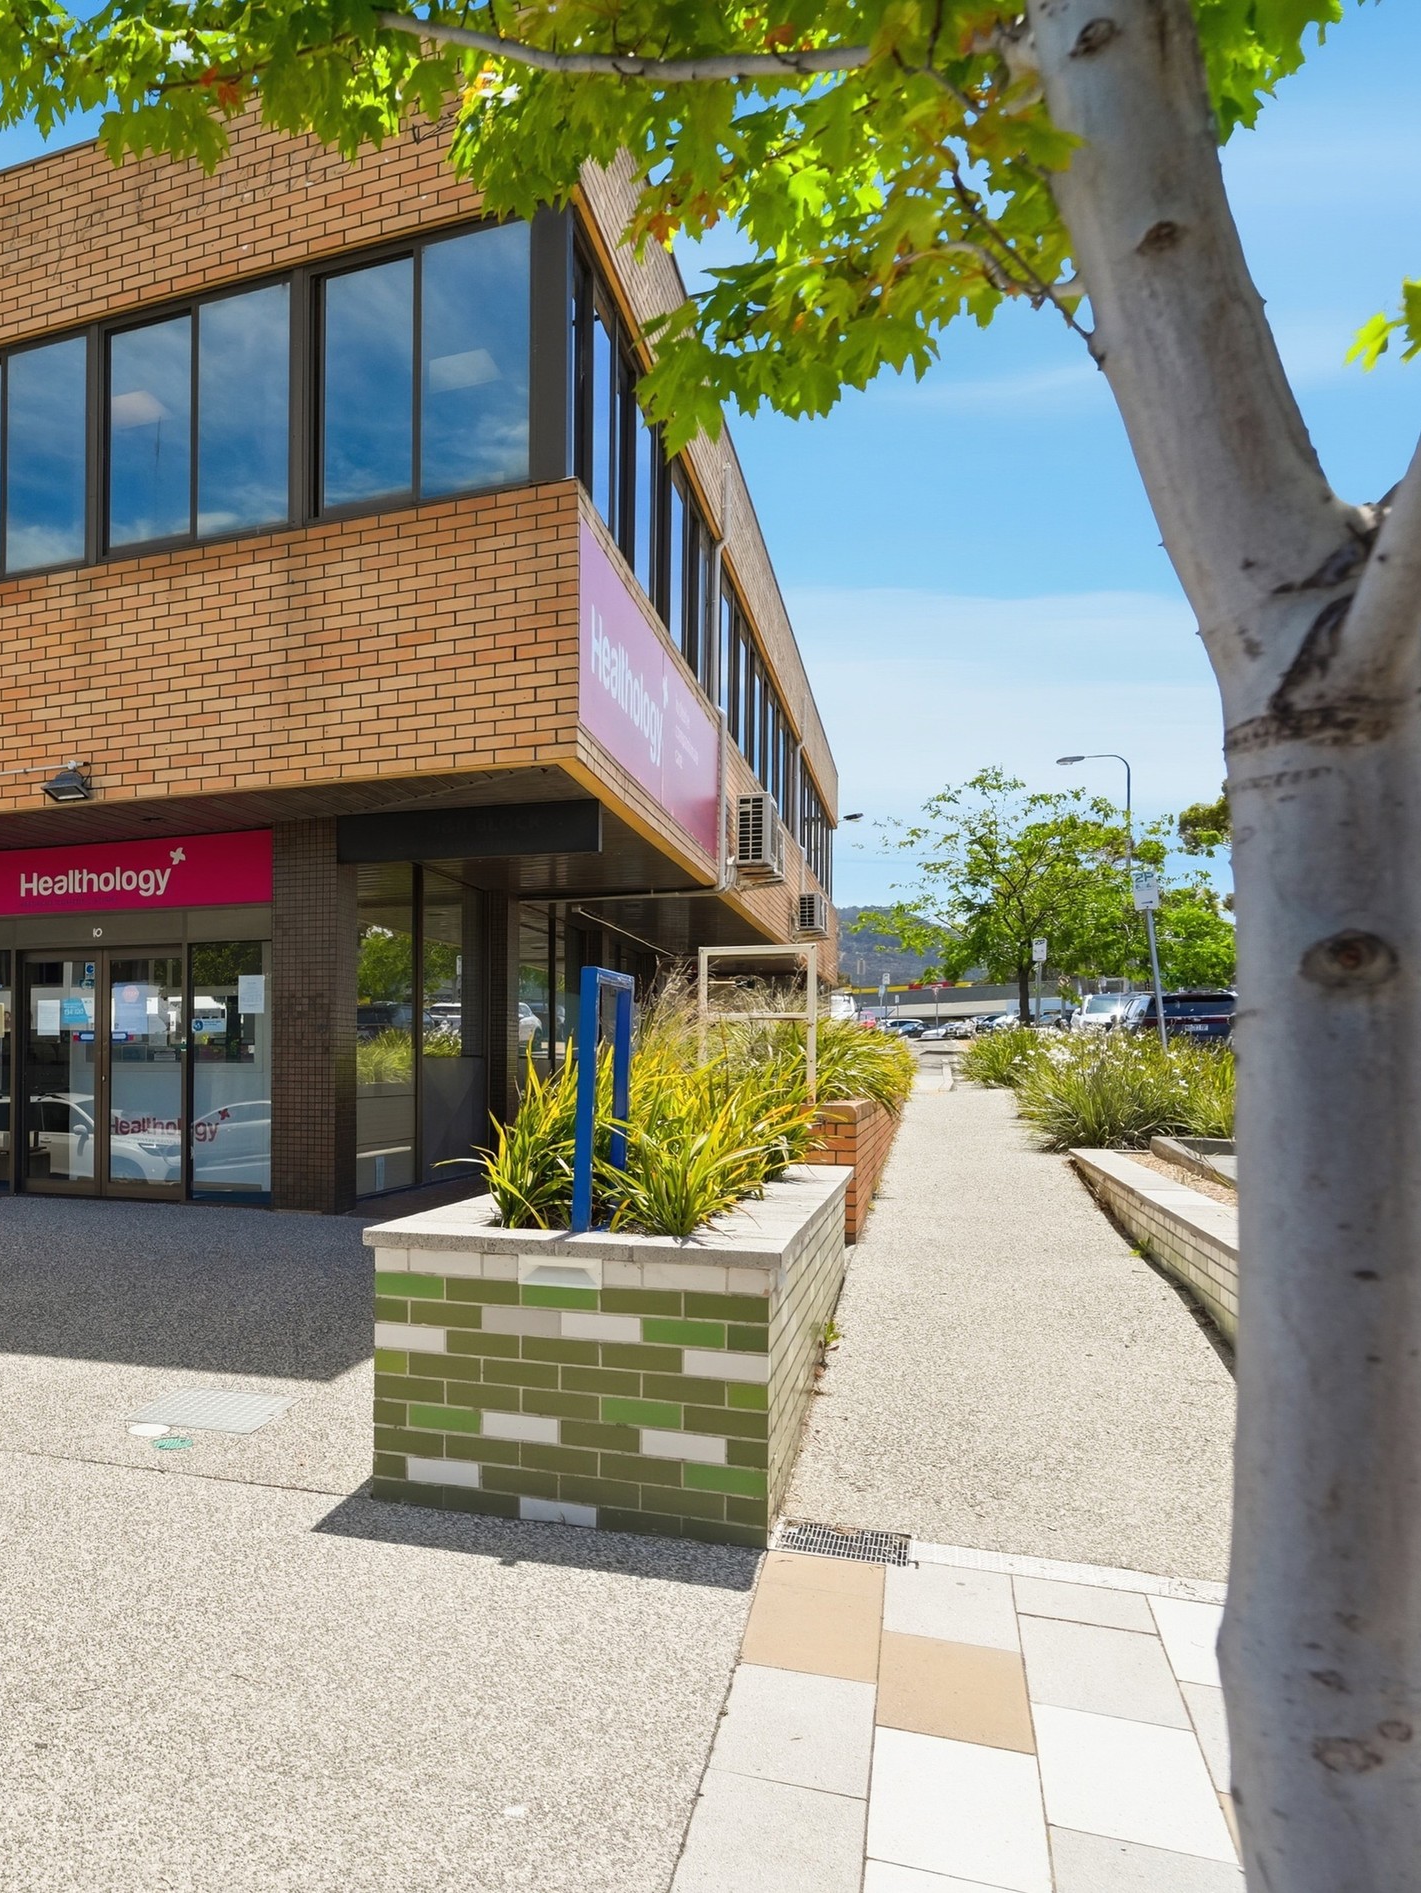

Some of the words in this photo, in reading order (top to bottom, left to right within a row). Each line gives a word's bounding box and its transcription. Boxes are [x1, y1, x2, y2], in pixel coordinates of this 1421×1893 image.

[591, 603, 664, 767] Healthology
[20, 866, 172, 897] Healthology
[92, 927, 103, 938] 10
[111, 1117, 219, 1142] Healtholgy
